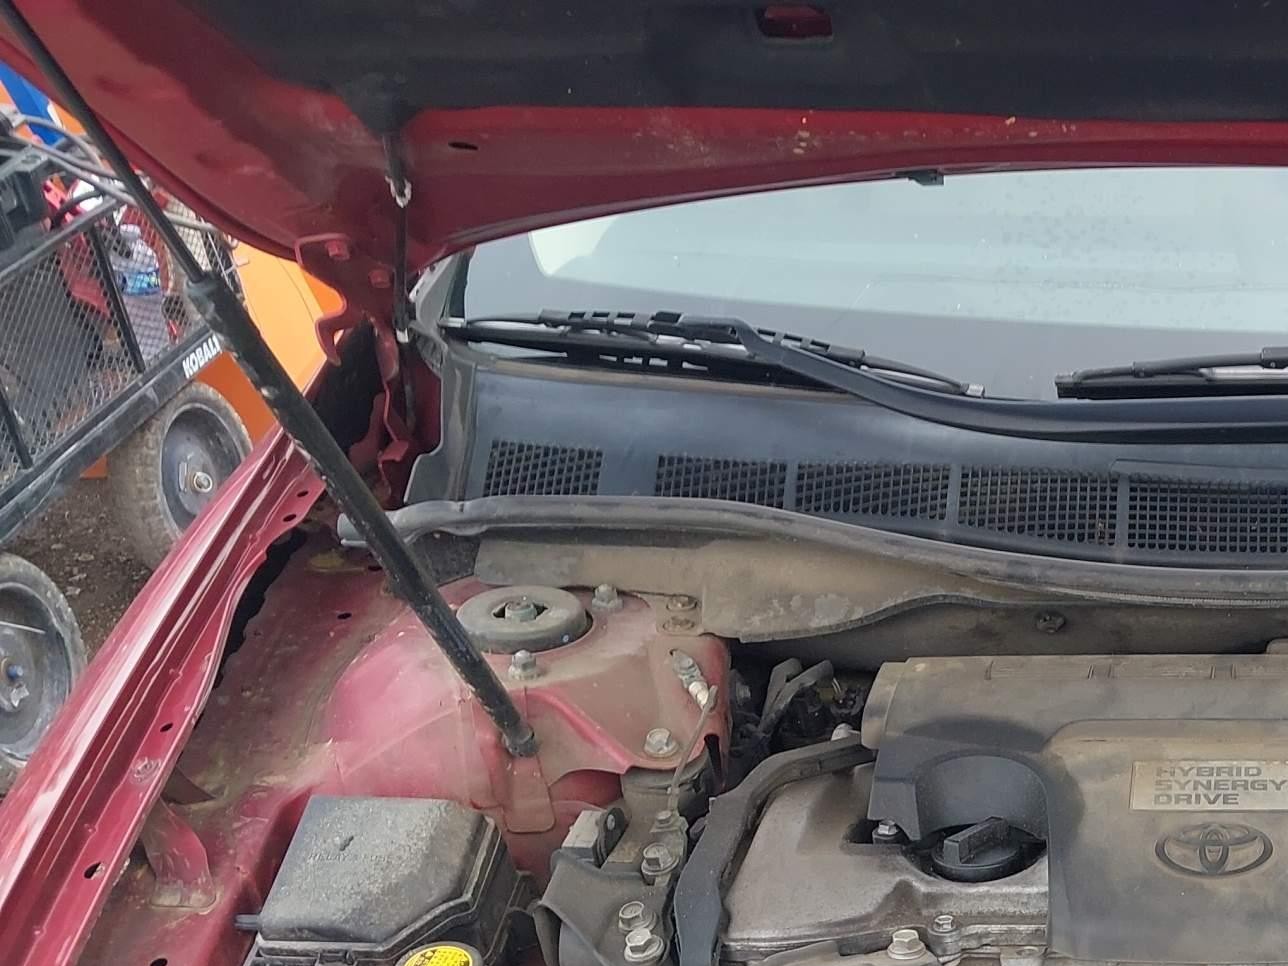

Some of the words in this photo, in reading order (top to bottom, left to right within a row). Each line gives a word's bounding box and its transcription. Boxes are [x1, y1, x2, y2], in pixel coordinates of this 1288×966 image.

[1156, 766, 1262, 777] HYBRID
[1154, 779, 1288, 791] SYNERGY
[1153, 793, 1240, 805] DRIVE
